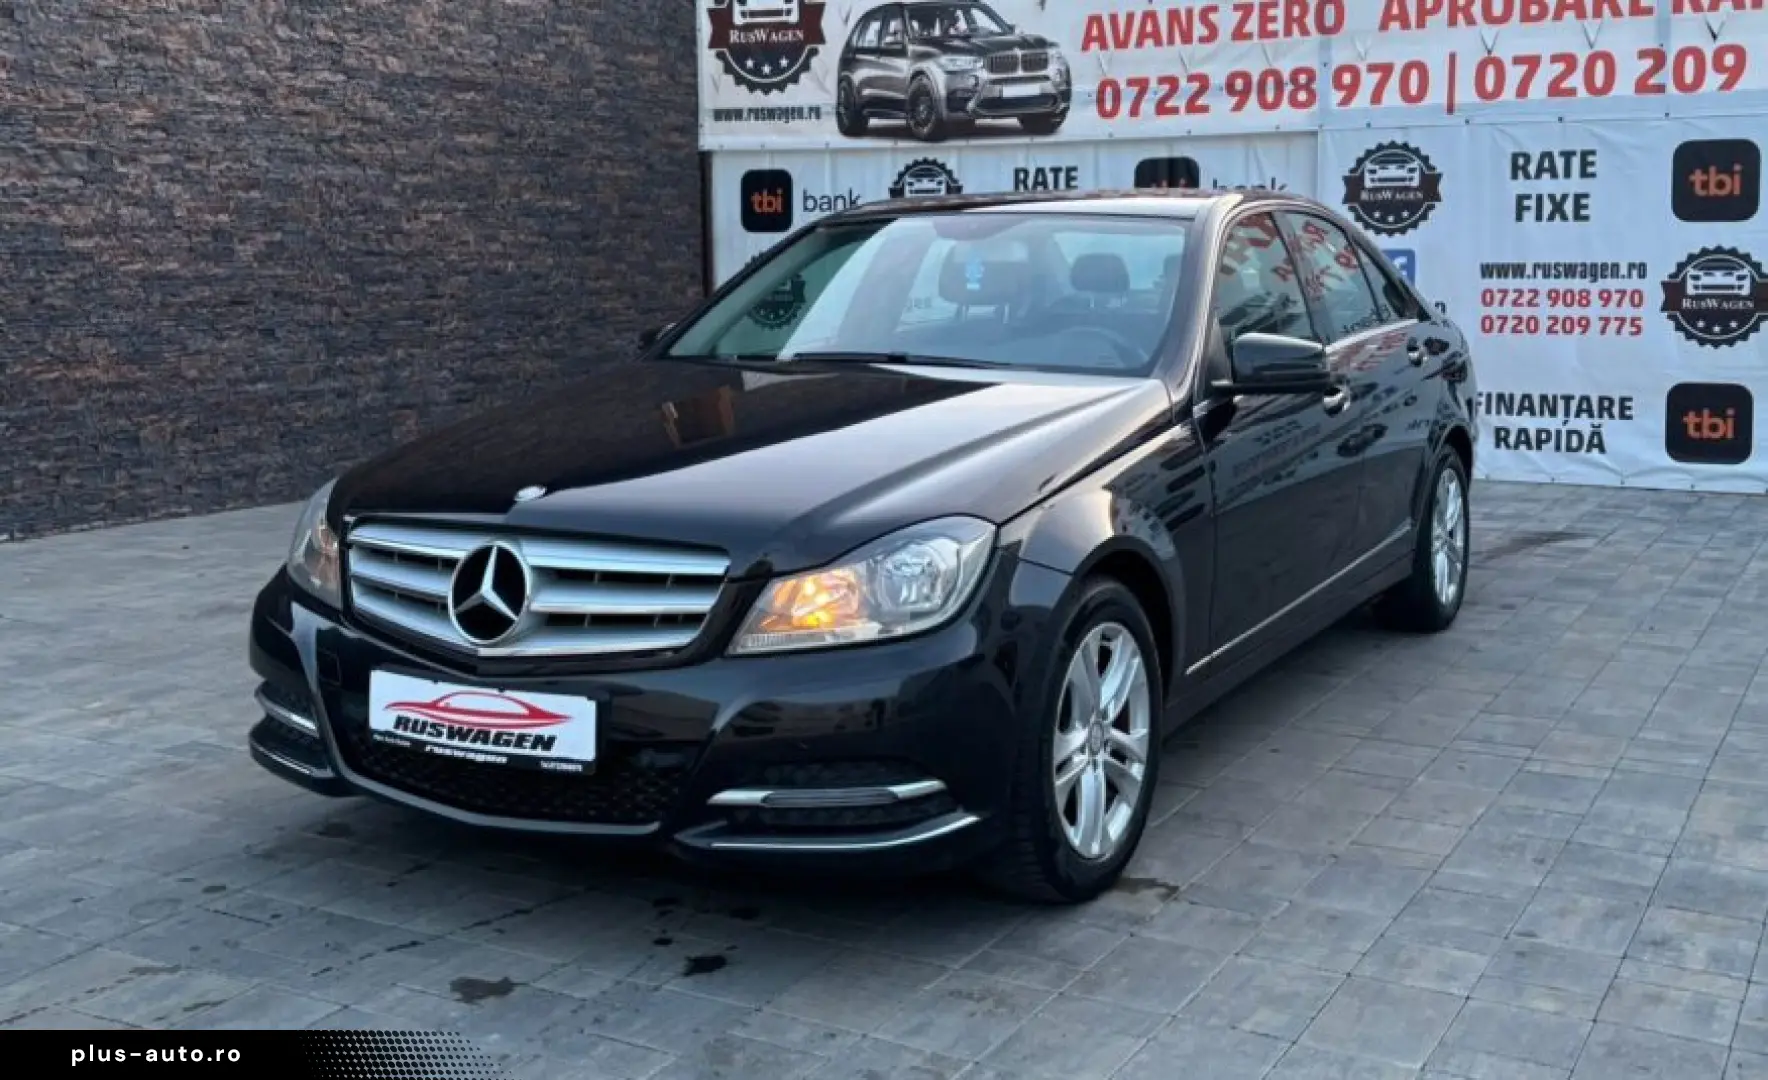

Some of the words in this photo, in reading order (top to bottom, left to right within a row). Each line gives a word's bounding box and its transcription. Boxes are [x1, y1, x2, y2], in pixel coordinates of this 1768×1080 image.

[1081, 5, 1219, 51] AVANS
[1231, 0, 1345, 41] ZERO
[1097, 73, 1210, 119] 0722
[1225, 67, 1318, 111] 908
[1332, 60, 1430, 107] 970
[1474, 50, 1616, 101] 0720
[1634, 44, 1747, 95] 209
[1014, 166, 1079, 191] RATE
[1511, 149, 1597, 180] RATE
[1689, 163, 1742, 196] tbi
[751, 187, 783, 213] tbi
[803, 188, 861, 213] bank
[1515, 193, 1591, 223] FIXE
[1480, 261, 1647, 283] www.ruswagen.ro
[1481, 288, 1540, 308] 0722
[1547, 288, 1592, 308] 908
[1598, 289, 1644, 308] 970
[1480, 314, 1540, 335] 0720
[1546, 315, 1591, 335] 209
[1598, 316, 1643, 336] 775
[1683, 407, 1735, 439] tbi
[1494, 424, 1607, 454] RAPIDĂ
[393, 714, 558, 752] RUSWAGEN
